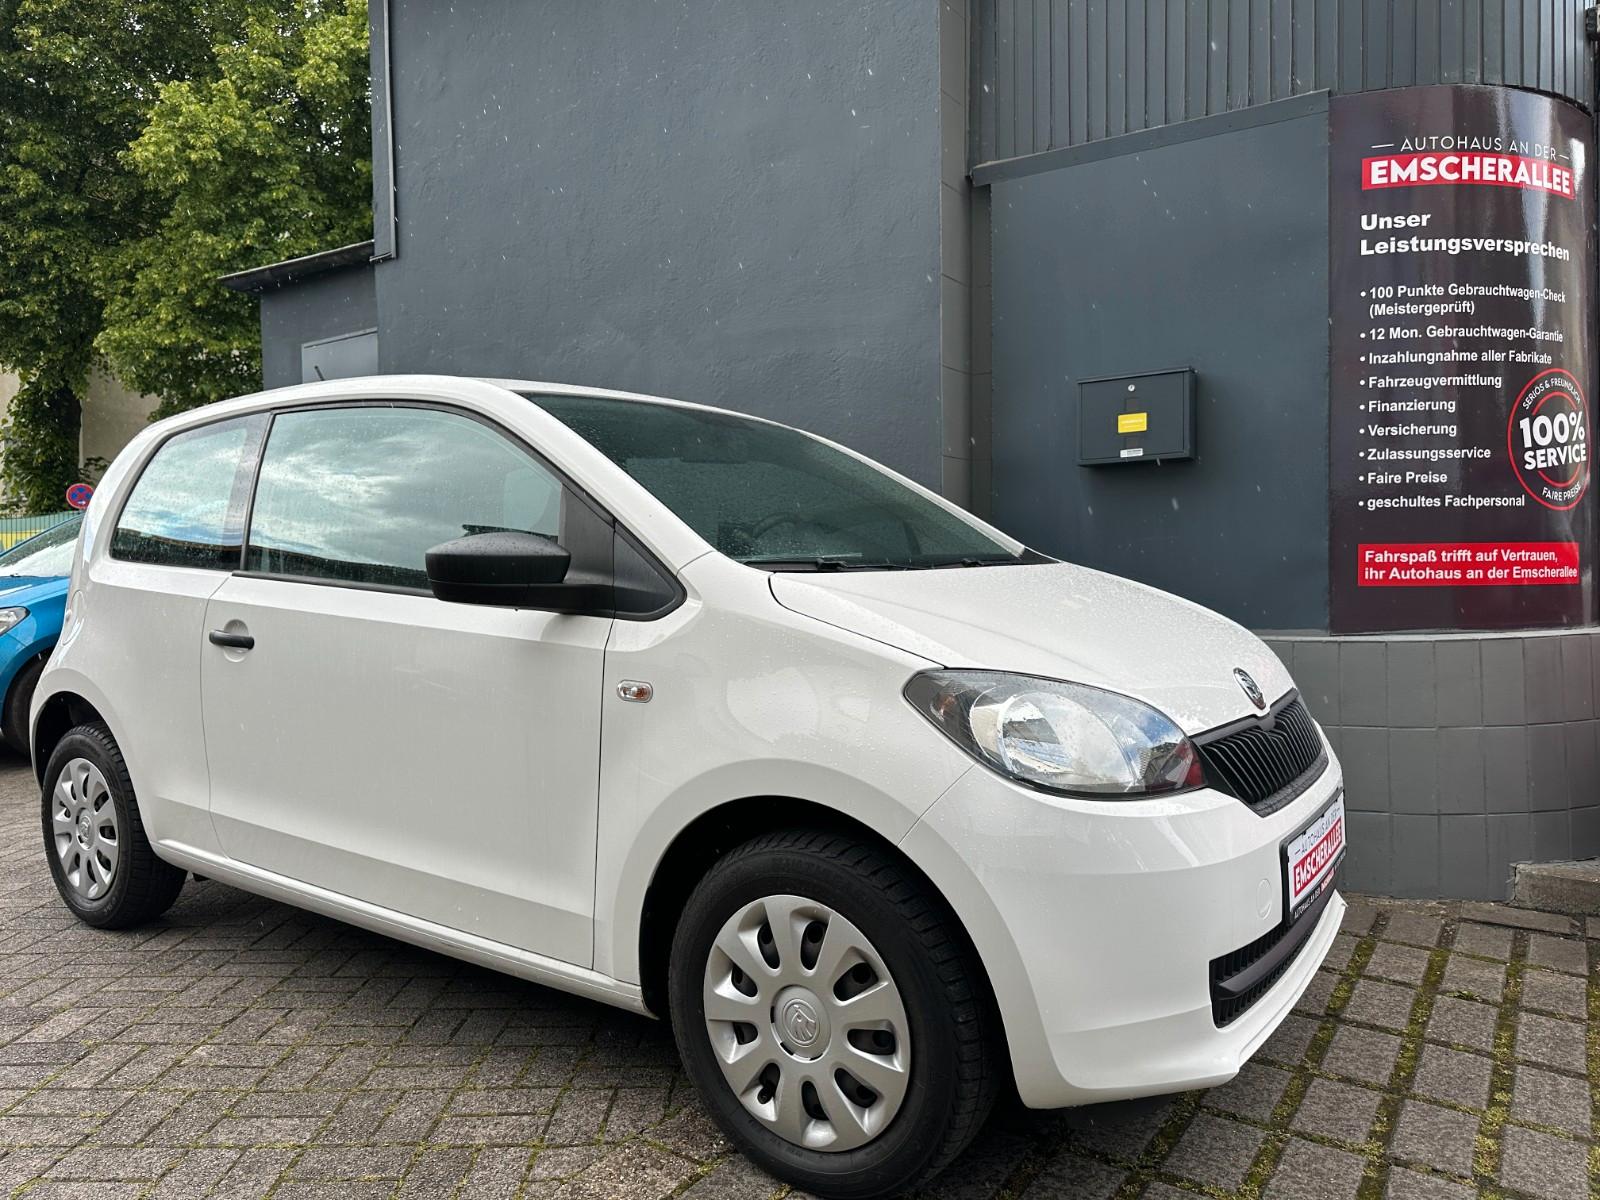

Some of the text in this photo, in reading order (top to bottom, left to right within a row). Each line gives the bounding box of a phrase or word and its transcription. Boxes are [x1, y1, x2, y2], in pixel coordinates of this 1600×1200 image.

[1400, 136, 1556, 160] AUTOHAUS AN DER
[1370, 156, 1570, 195] EMSCHERALLEE
[1361, 213, 1431, 231] Unser
[1361, 236, 1570, 261] Leistungsversprechen
[1370, 283, 1566, 303] 100 Punkte Gebrauchtwagen-Check
[1369, 301, 1475, 318] (Meistergeprüft)
[1370, 325, 1563, 342] 12 Mon. Gebrauchtwagen-Garantie
[1368, 350, 1552, 365] Inzahlungnahme aller Fabrikate
[1368, 375, 1502, 388] Fahrzeugvermittlung
[1544, 379, 1550, 389] &
[1368, 399, 1456, 413] Finanzierung
[1368, 423, 1457, 437] Versicherung
[1519, 411, 1586, 448] 100%
[1367, 446, 1491, 461] Zulassungsservice
[1523, 443, 1587, 470] SERVICE
[1367, 471, 1447, 484] Faire Preise
[1542, 486, 1563, 501] FAIRE
[1367, 494, 1525, 510] geschultes Fachpersonal
[1364, 549, 1558, 564] Fahrspaß trifft auf Vertrauen,
[1364, 566, 1577, 580] ihr Autohaus an der Emscherallee
[1295, 821, 1342, 890] EMSCHERALLEE
